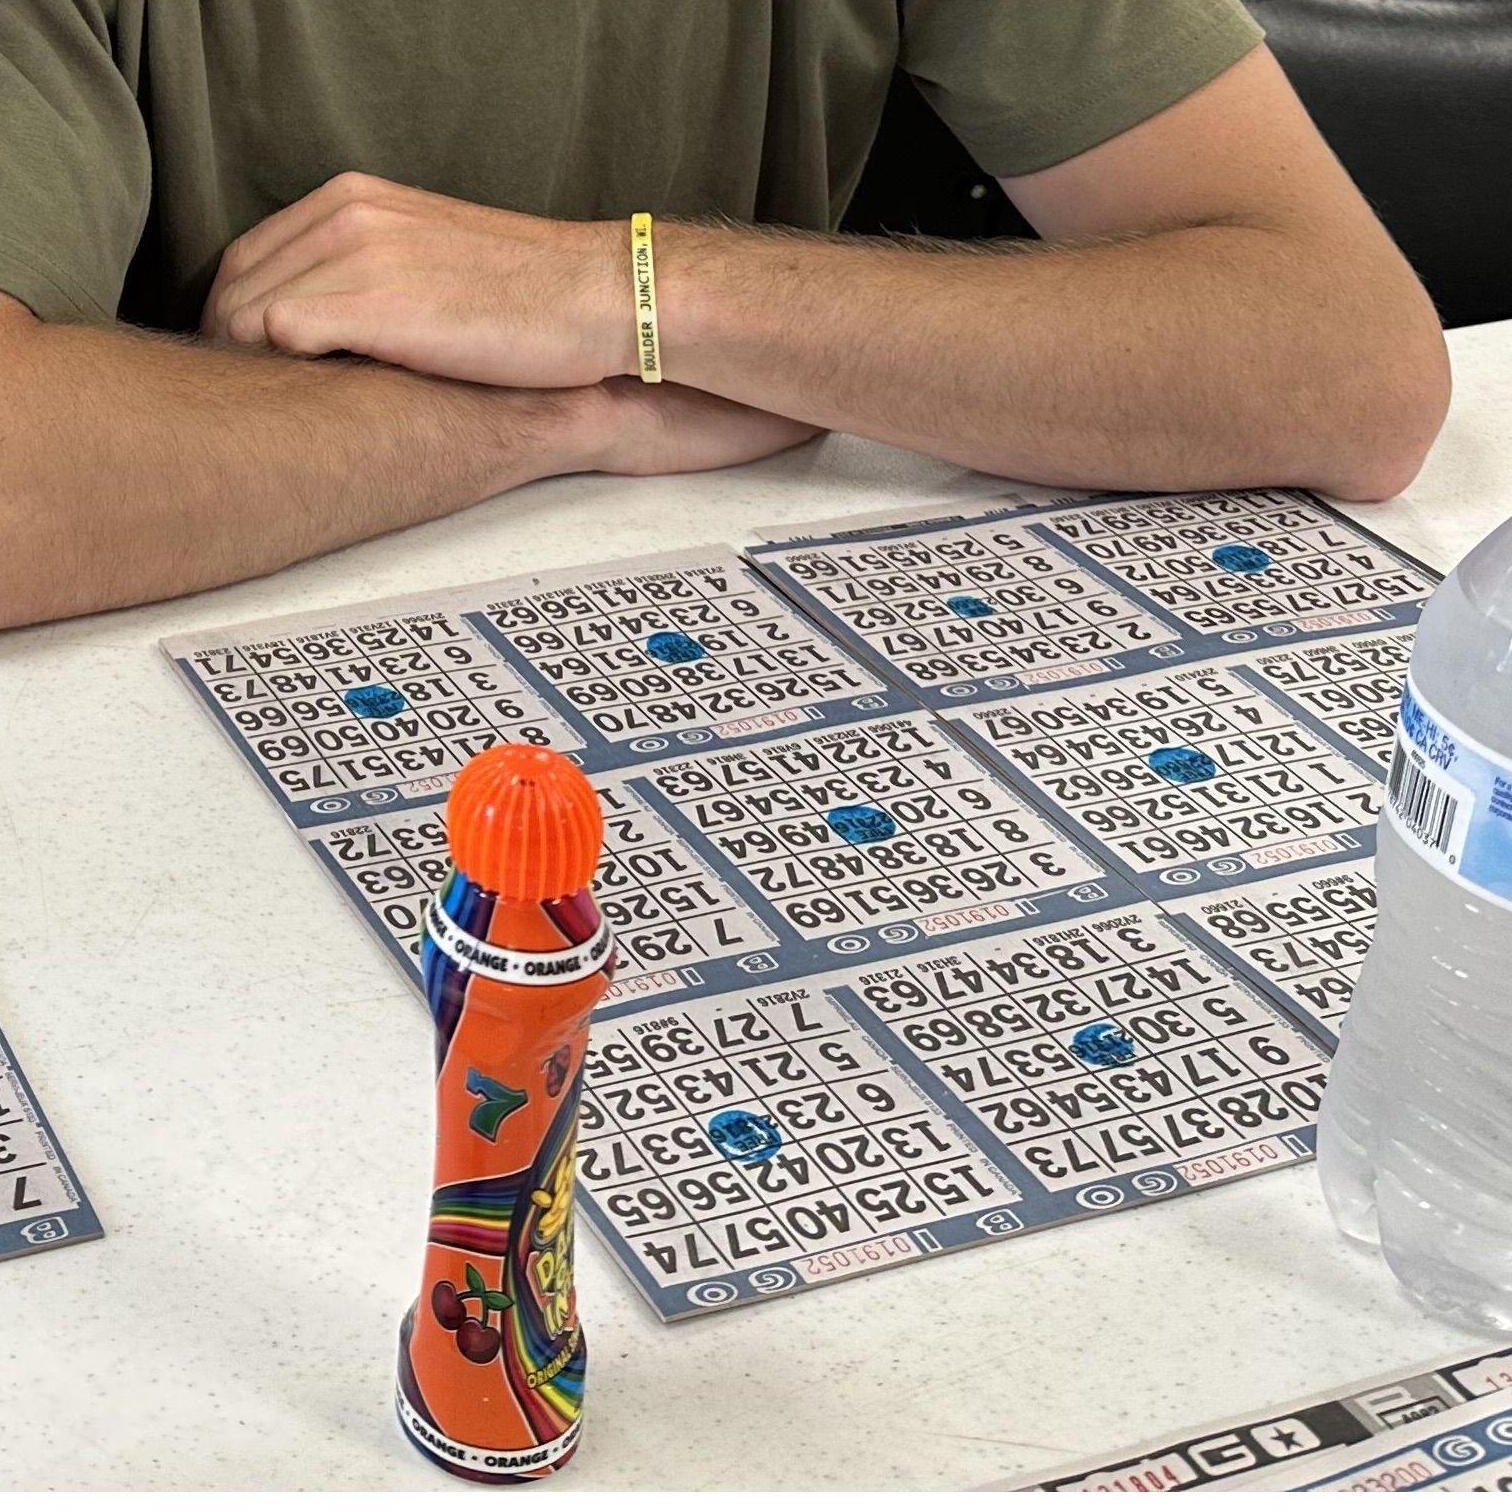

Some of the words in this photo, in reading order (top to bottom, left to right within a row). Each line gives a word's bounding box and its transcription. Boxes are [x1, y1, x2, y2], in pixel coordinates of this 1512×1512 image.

[642, 321, 657, 372] BOULDER
[1332, 582, 1379, 606] 27
[1372, 574, 1425, 597] 15
[1231, 598, 1288, 620] 55
[1285, 591, 1332, 613] 37
[1116, 621, 1152, 641] 2
[1183, 607, 1236, 628] 65
[1302, 611, 1372, 630] 0191052
[776, 644, 831, 667] 13
[1012, 640, 1063, 663] 34
[1059, 630, 1113, 655] 23
[672, 662, 726, 687] 38
[732, 653, 779, 677] 17
[905, 658, 959, 681] 68
[956, 650, 1014, 672] 53
[1025, 661, 1106, 683] 0191052
[566, 682, 619, 706] 69
[619, 674, 672, 697] 60
[426, 704, 481, 731] 20
[494, 698, 525, 719] 9
[720, 706, 799, 734] 0191052
[313, 725, 370, 751] 50
[370, 717, 419, 742] 40
[257, 735, 310, 762] 69
[1243, 769, 1305, 798] 21
[1307, 762, 1346, 785] 1
[1133, 793, 1200, 821] 52
[1189, 781, 1251, 808] 31
[992, 819, 1030, 843] 8
[1081, 805, 1141, 833] 66
[866, 840, 928, 870] 38
[924, 827, 985, 858] 18
[1248, 834, 1343, 864] 0191052
[747, 861, 815, 893] 72
[809, 852, 865, 881] 48
[1266, 896, 1331, 926] 55
[1322, 883, 1377, 914] 45
[924, 903, 1010, 931] 0191052
[1207, 909, 1270, 939] 68
[454, 939, 508, 972] ORANGE
[524, 955, 582, 976] ORANGE
[1248, 1036, 1290, 1066] 9
[1180, 1047, 1242, 1088] 17
[1109, 1067, 1173, 1104] 43
[1045, 1082, 1120, 1120] 54
[978, 1097, 1051, 1134] 62
[1179, 1142, 1282, 1181] 0191052
[923, 1164, 995, 1206] 15
[855, 1179, 927, 1223] 25
[785, 1200, 851, 1240] 40
[725, 1217, 791, 1260] 57
[642, 1233, 719, 1275] 74
[807, 1238, 912, 1278] 0191052
[411, 1417, 466, 1462] ORANGE
[484, 1448, 549, 1469] ORANGE
